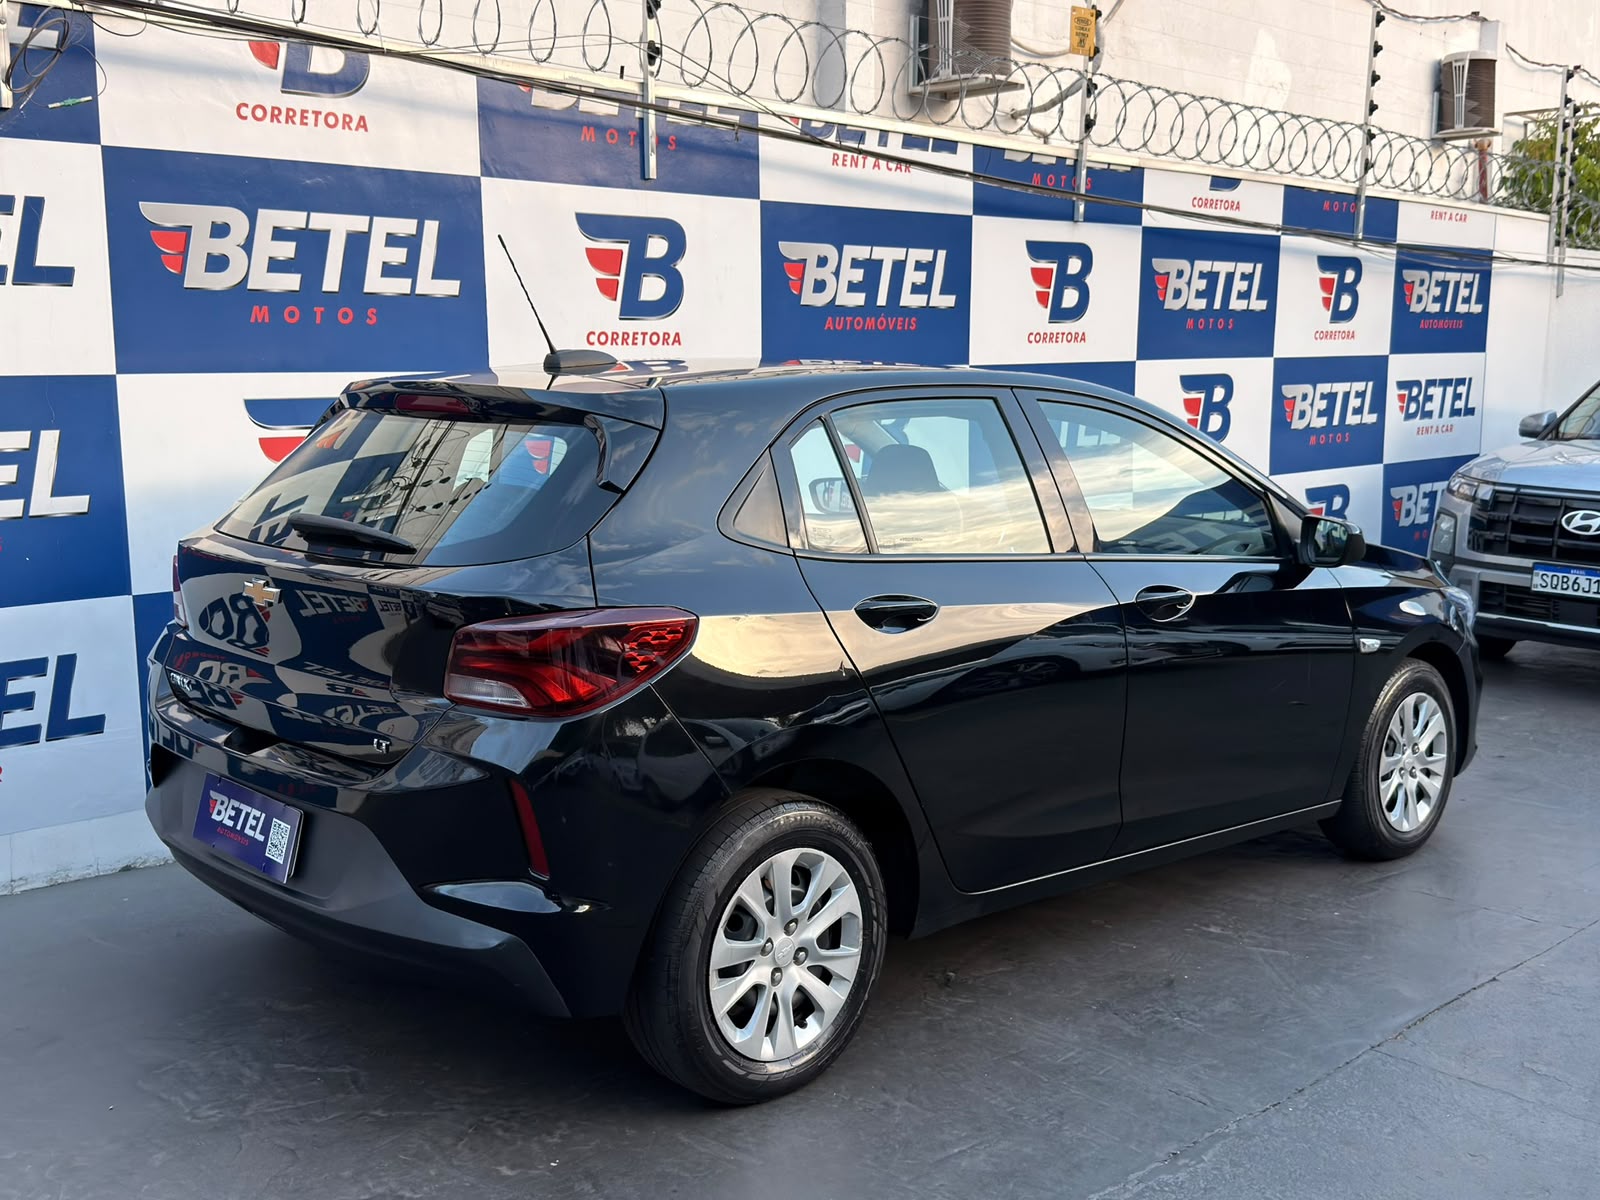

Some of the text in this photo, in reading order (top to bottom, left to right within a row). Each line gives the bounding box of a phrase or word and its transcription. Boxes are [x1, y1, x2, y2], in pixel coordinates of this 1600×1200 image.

[235, 102, 369, 133] CORRETORA
[580, 124, 678, 151] MOTS
[831, 152, 912, 173] RENT A CAR
[1191, 196, 1241, 212] CORRETORA
[1323, 200, 1357, 213] MOTO
[1430, 210, 1447, 221] RENT
[1454, 212, 1468, 223] CAR
[139, 201, 461, 297] BETEL
[574, 212, 687, 321] B
[778, 241, 957, 309] BETEL
[1025, 240, 1093, 324] B
[1151, 258, 1268, 311] BETEL
[1316, 255, 1363, 324] B
[1402, 269, 1483, 314] BETEL
[249, 305, 378, 325] MOTOS
[824, 312, 917, 331] AUTOMÓVEIS
[1186, 318, 1235, 330] MOTOS
[1419, 318, 1464, 329] AUTOMÓVEIS
[586, 330, 682, 347] CORRETORA
[1027, 330, 1087, 345] CORRETORA
[1314, 330, 1356, 341] CORRETORA
[1179, 373, 1234, 443] B
[1281, 381, 1379, 431] BETEL
[1395, 377, 1476, 422] BETEL
[1309, 432, 1351, 446] MOTOS
[1416, 425, 1433, 435] RENT
[1441, 423, 1454, 434] CAR
[1390, 480, 1450, 527] BET
[209, 790, 266, 842] BETEL
